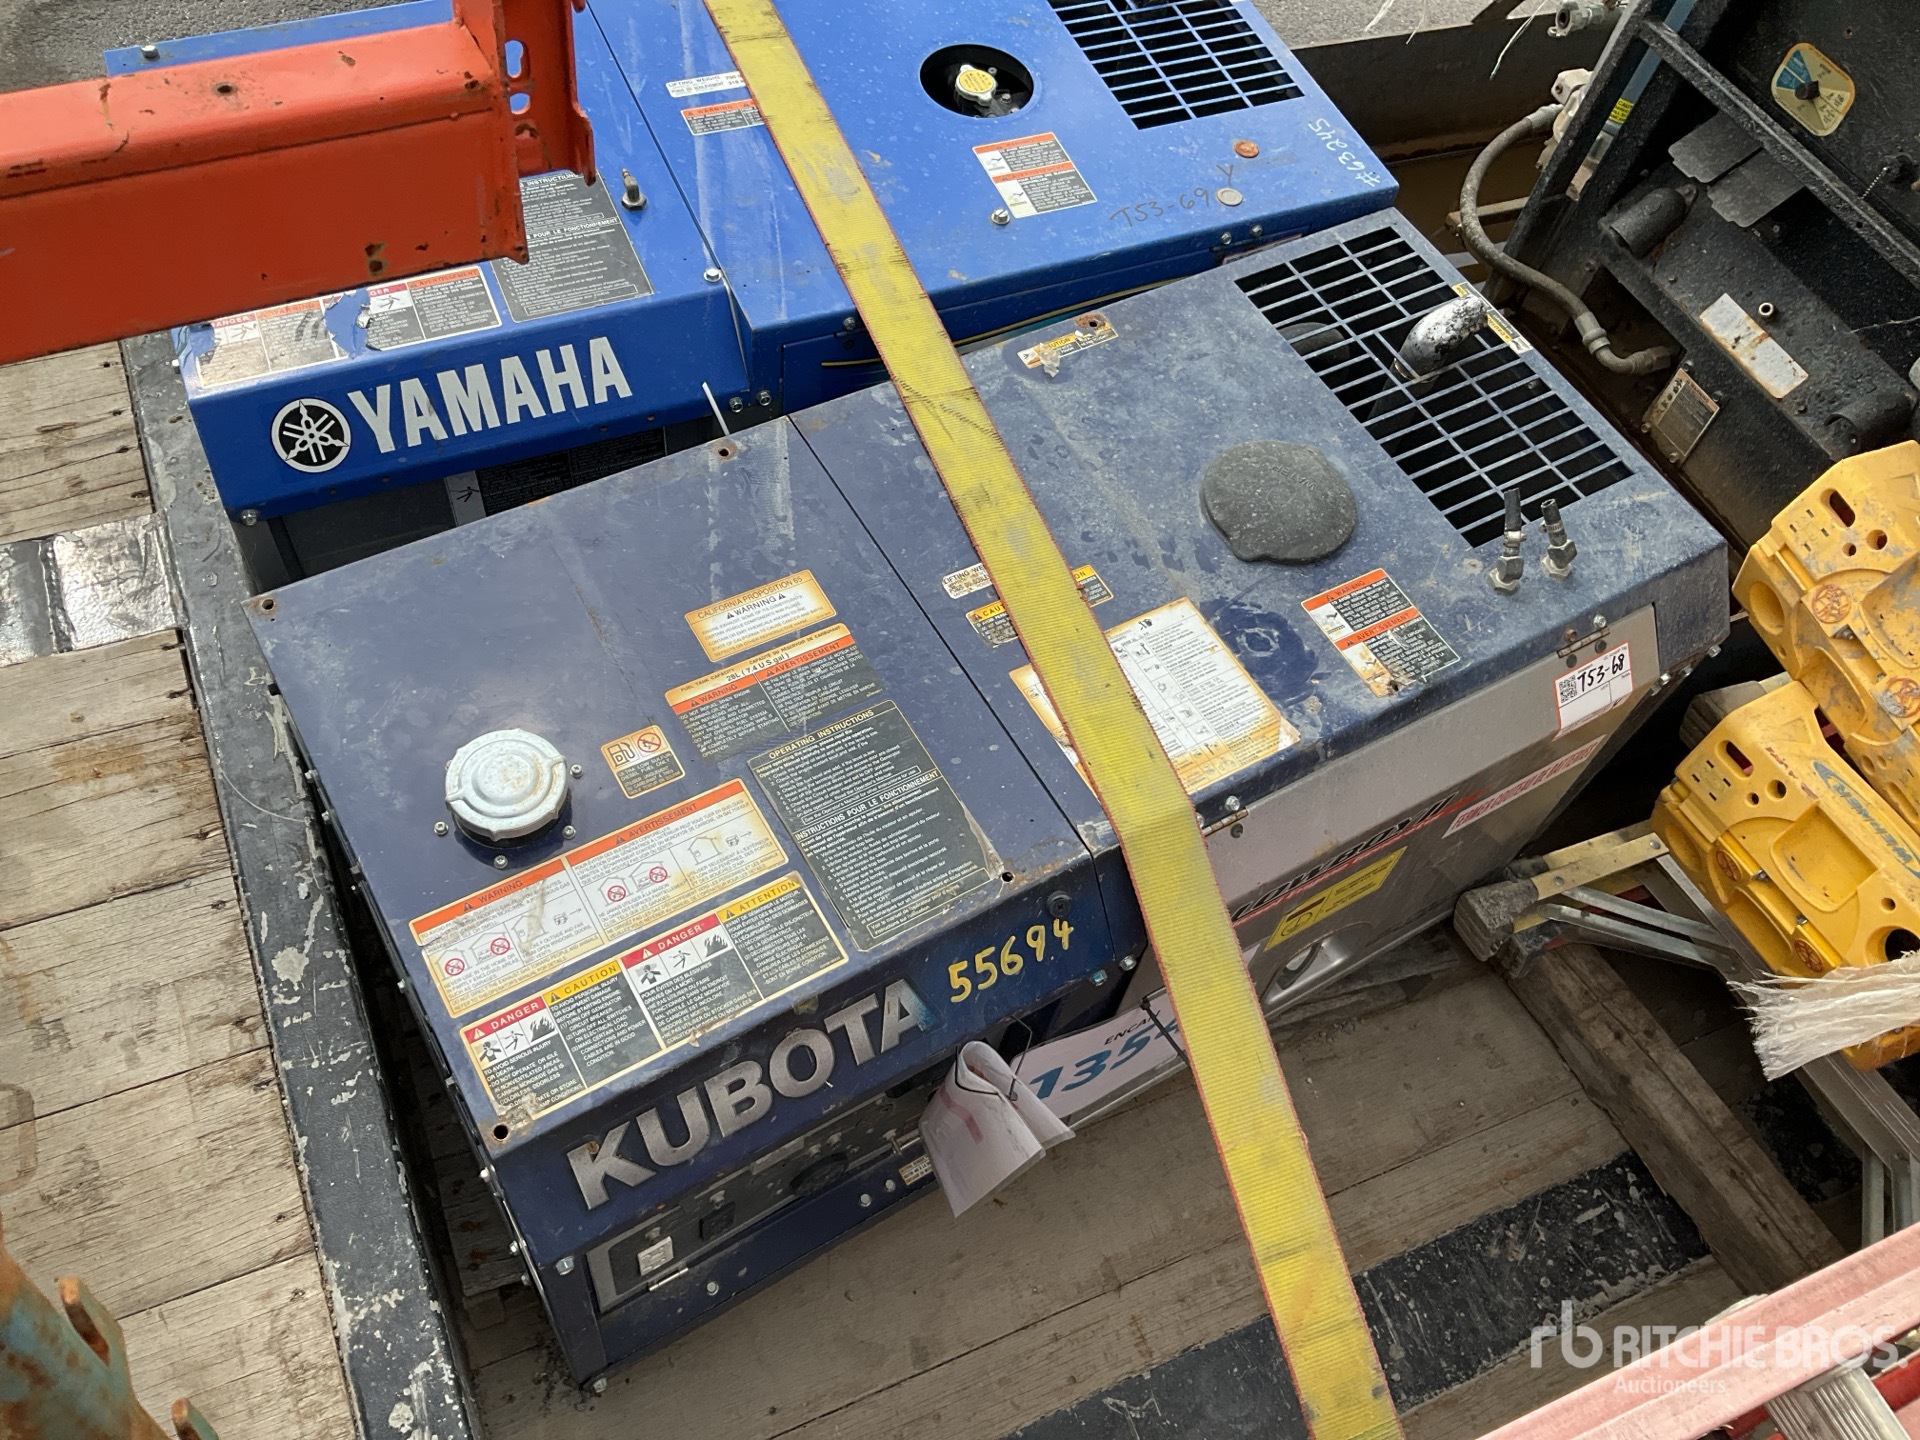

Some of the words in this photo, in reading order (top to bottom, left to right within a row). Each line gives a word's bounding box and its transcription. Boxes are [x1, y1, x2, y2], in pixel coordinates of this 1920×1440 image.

[211, 314, 250, 329] ANGER
[347, 336, 633, 454] YAMAHA
[696, 597, 743, 619] CALIFORNIA
[741, 579, 793, 602] PROPOSITION
[791, 575, 803, 583] 65
[1334, 579, 1365, 596] WARNING
[733, 595, 777, 616] WARNING
[773, 641, 842, 673] AVERTISSEMENT
[726, 671, 740, 681] 28L
[698, 683, 738, 703] WARNING
[767, 734, 815, 759] OPERATING
[816, 709, 875, 738] INSTRUCTIONS
[794, 813, 846, 841] INSTRUCTIONS
[846, 803, 867, 817] POUR
[867, 798, 878, 807] LE
[878, 770, 939, 802] FONCTIONNEMENT
[627, 802, 698, 838] AVERTISSEMENT
[477, 879, 523, 904] WARNING
[738, 879, 795, 912] ATTENTION
[657, 924, 702, 949] DANGER
[948, 918, 1074, 1003] 55694
[563, 965, 616, 994] CAUTION
[558, 997, 574, 1007] AVOID
[574, 984, 600, 1000] PERSONAL
[561, 996, 590, 1013] EQUIPMENT
[490, 1001, 539, 1029] DANGER
[491, 1060, 509, 1071] AVOID
[567, 979, 937, 1211] KUBOTA
